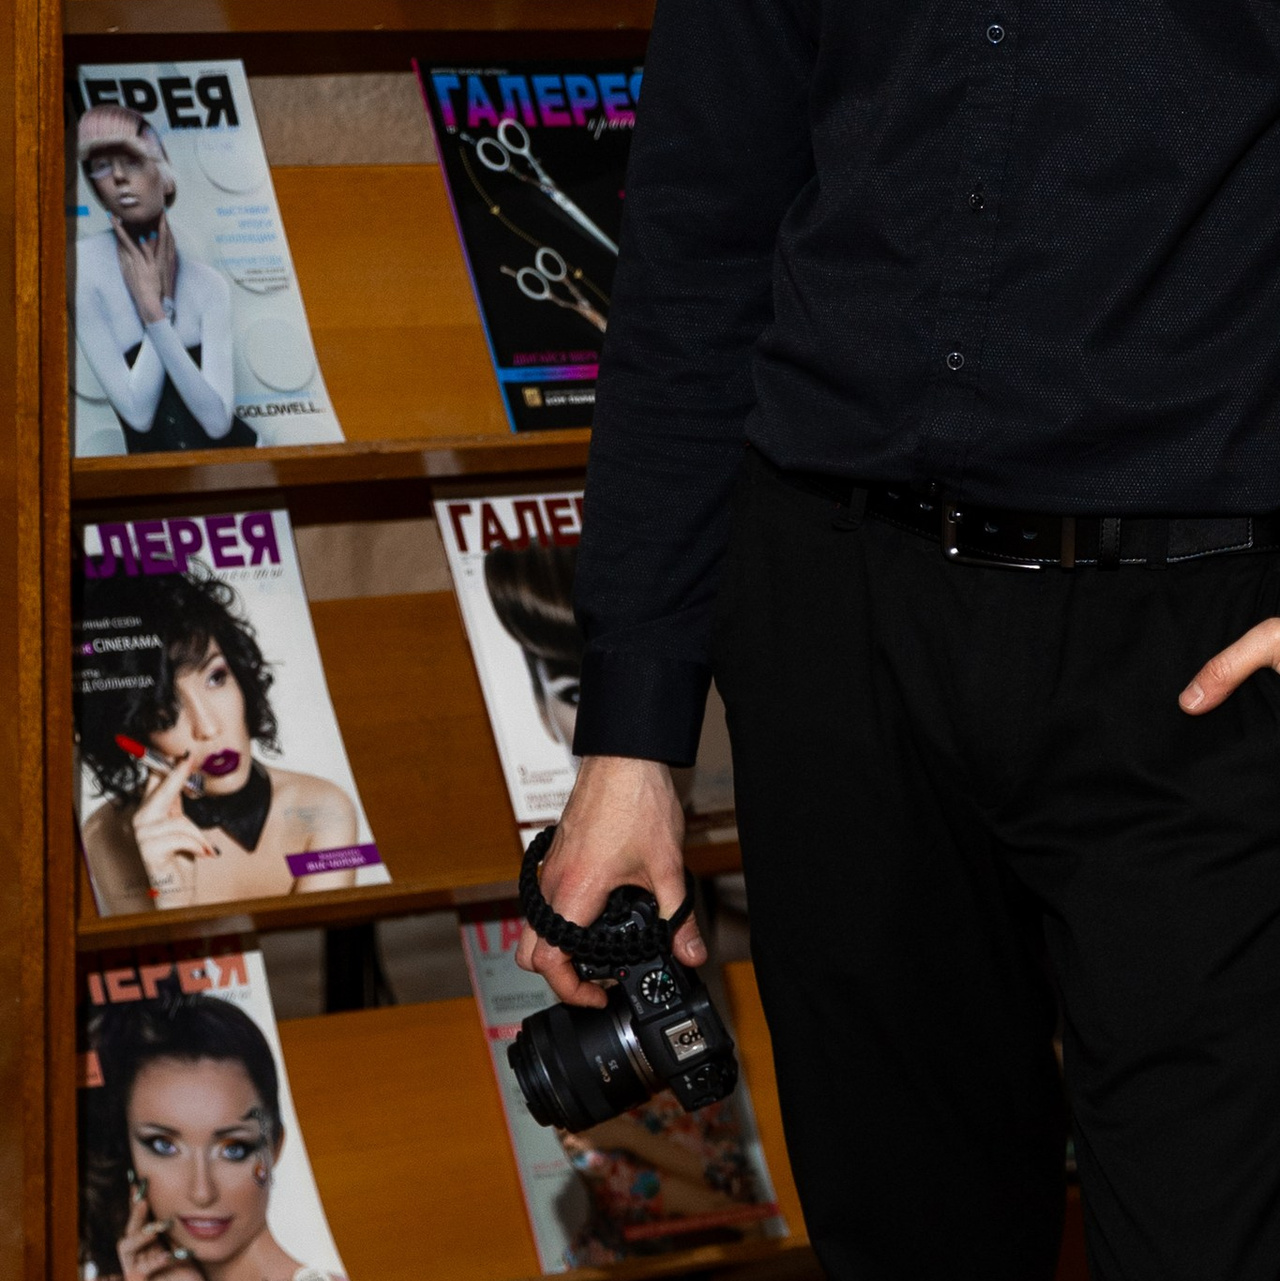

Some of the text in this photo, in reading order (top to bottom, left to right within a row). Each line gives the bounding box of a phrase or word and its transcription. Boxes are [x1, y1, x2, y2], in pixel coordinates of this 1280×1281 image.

[82, 75, 240, 130] ЕРЕЯ
[84, 511, 280, 580] ЛЕРЕЯ
[92, 634, 164, 654] CINERAMA
